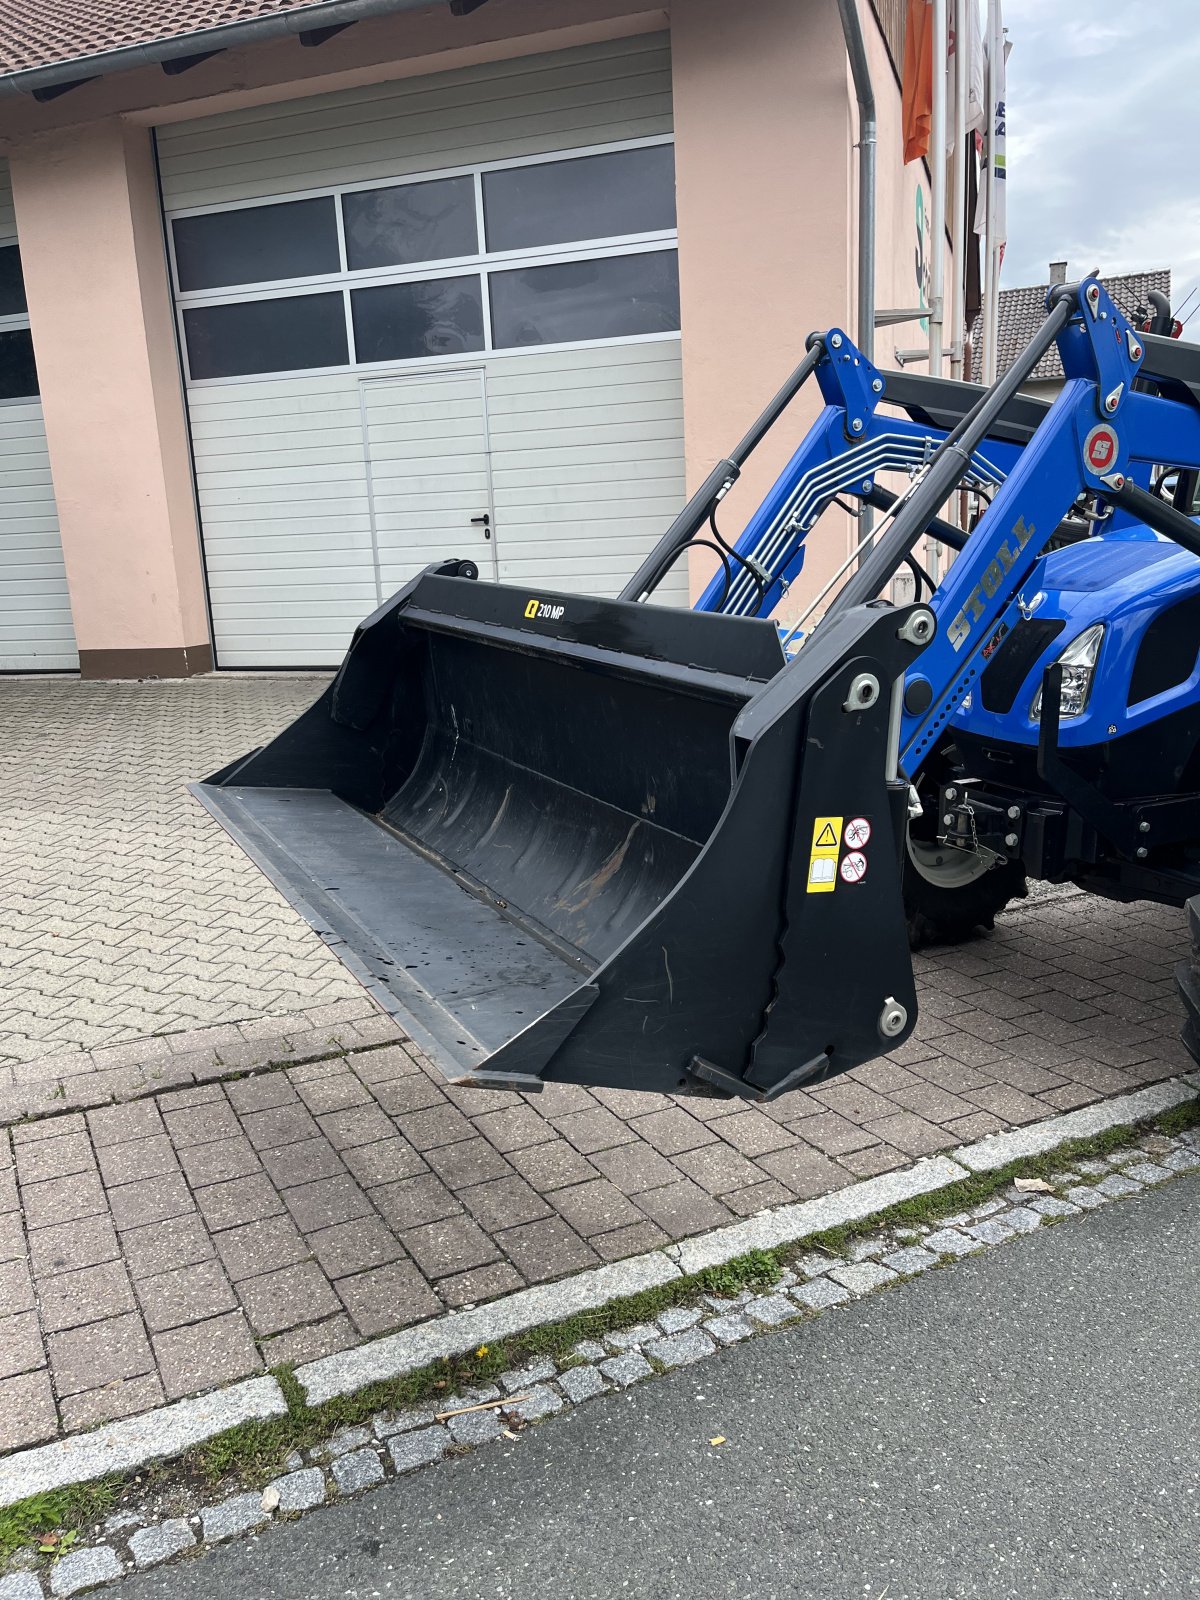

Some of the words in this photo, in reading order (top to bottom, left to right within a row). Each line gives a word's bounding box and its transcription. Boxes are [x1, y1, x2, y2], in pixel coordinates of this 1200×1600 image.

[537, 603, 552, 618] 210
[550, 605, 565, 620] MP
[946, 515, 1036, 652] STOLL
